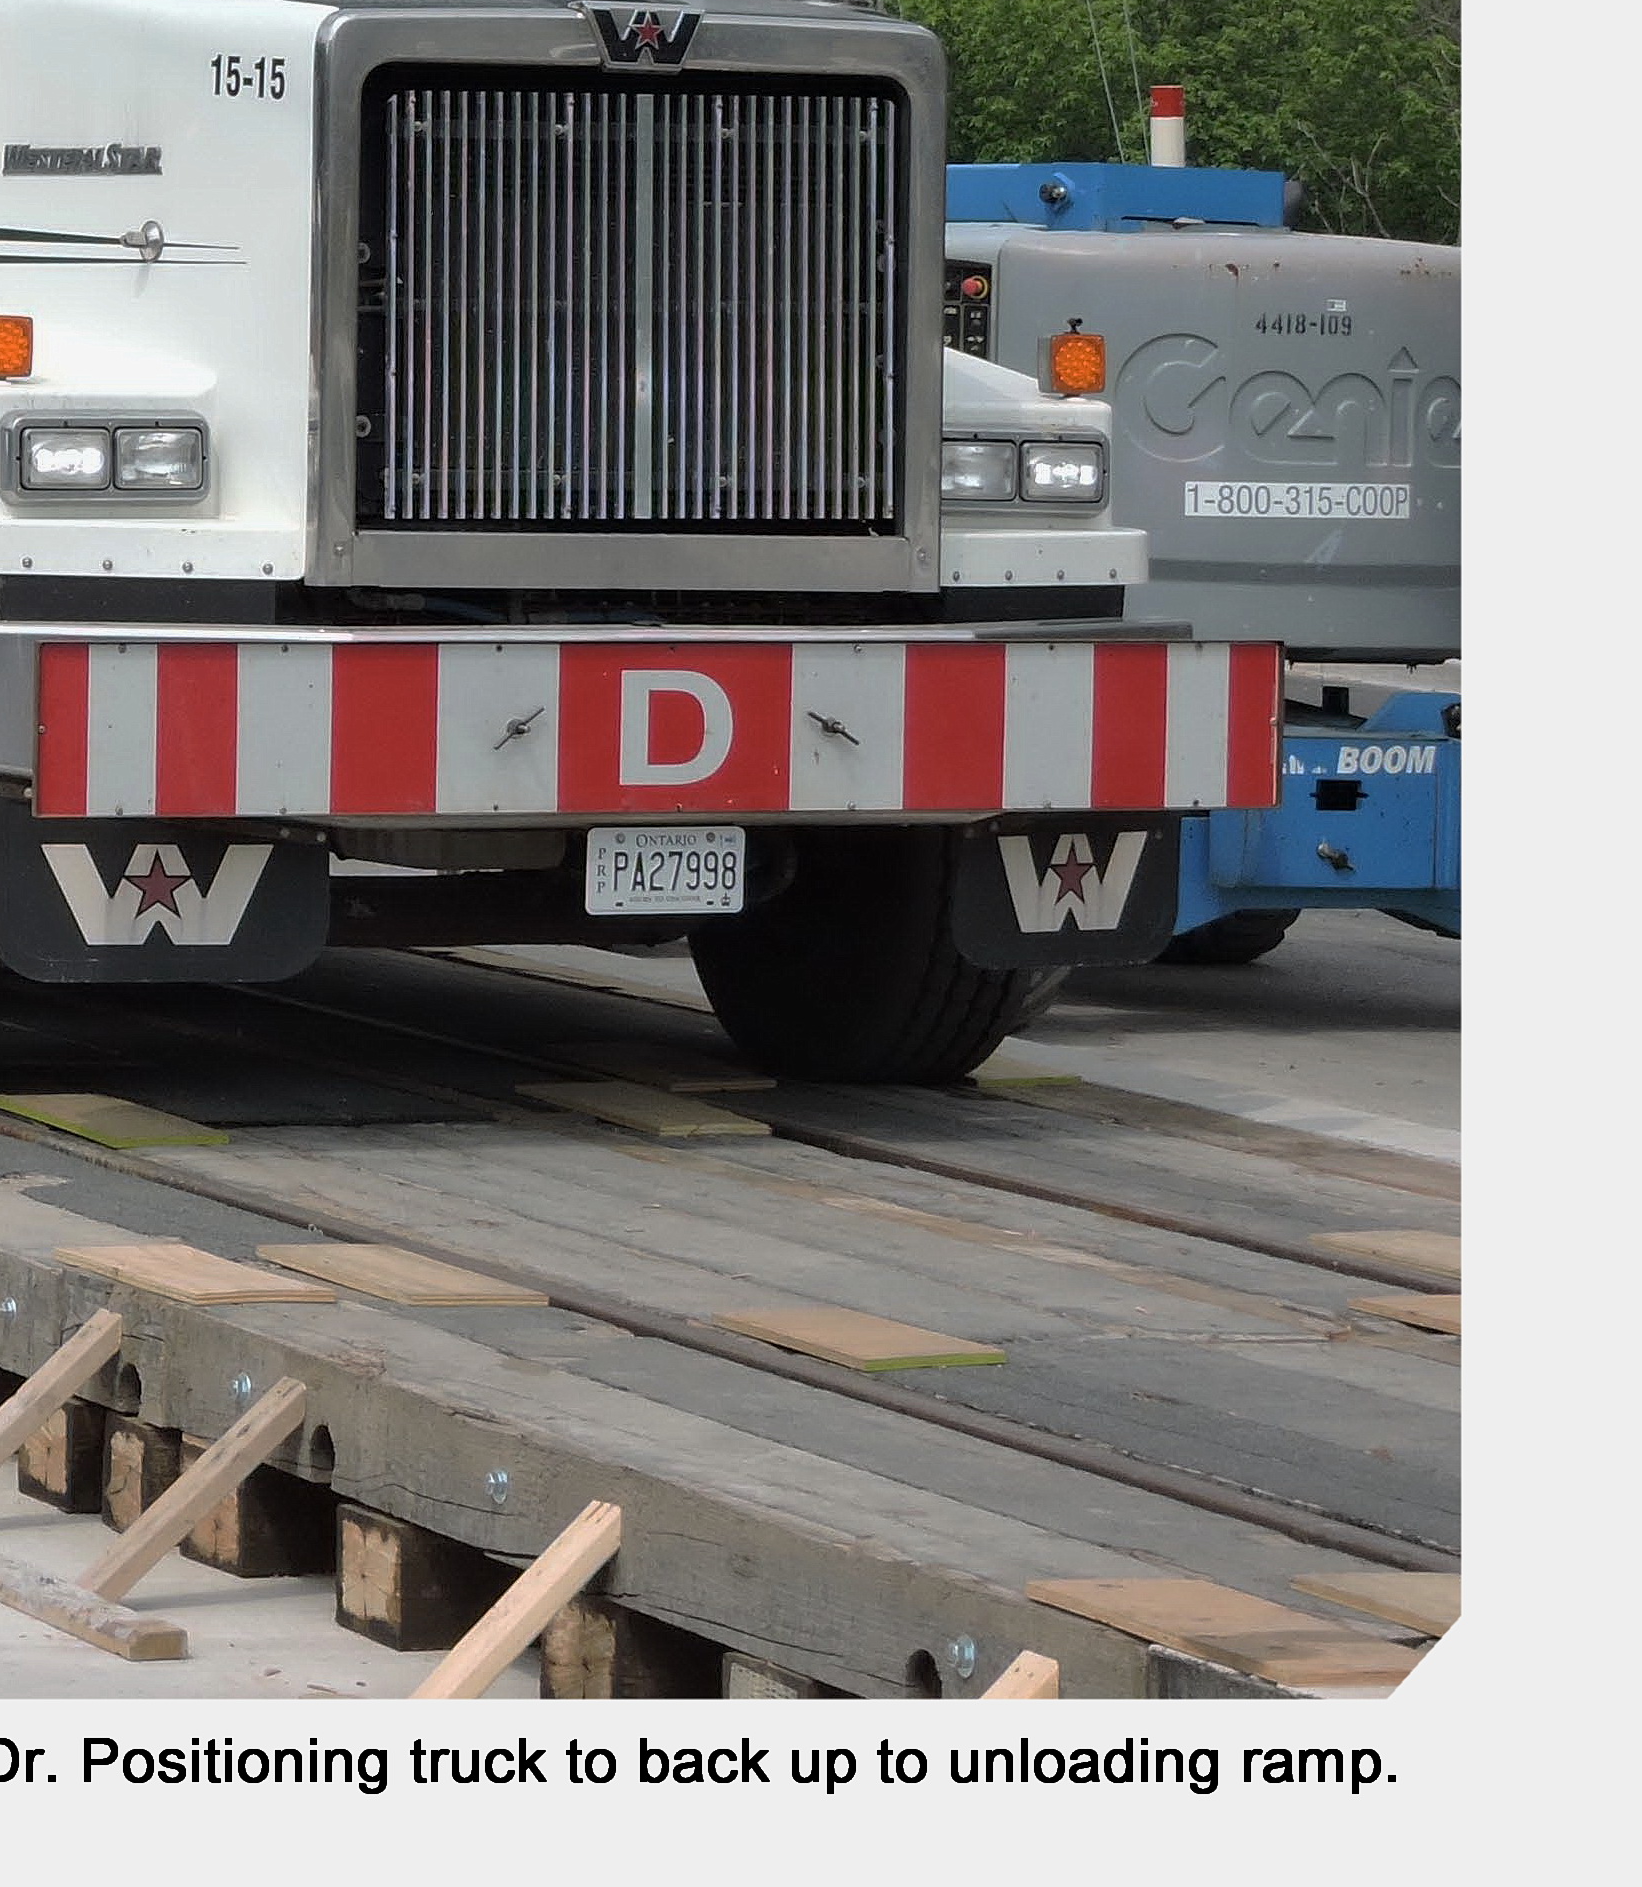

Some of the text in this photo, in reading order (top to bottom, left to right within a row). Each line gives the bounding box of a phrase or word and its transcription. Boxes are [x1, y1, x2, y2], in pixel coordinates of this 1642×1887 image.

[210, 54, 287, 100] 15-15
[1254, 312, 1353, 337] 4418-109
[1186, 483, 1409, 517] 1-800-315-COOP
[617, 669, 735, 787] D
[1336, 745, 1437, 774] BOOM
[635, 833, 698, 848] ONTARIO
[612, 851, 737, 892] PA27998
